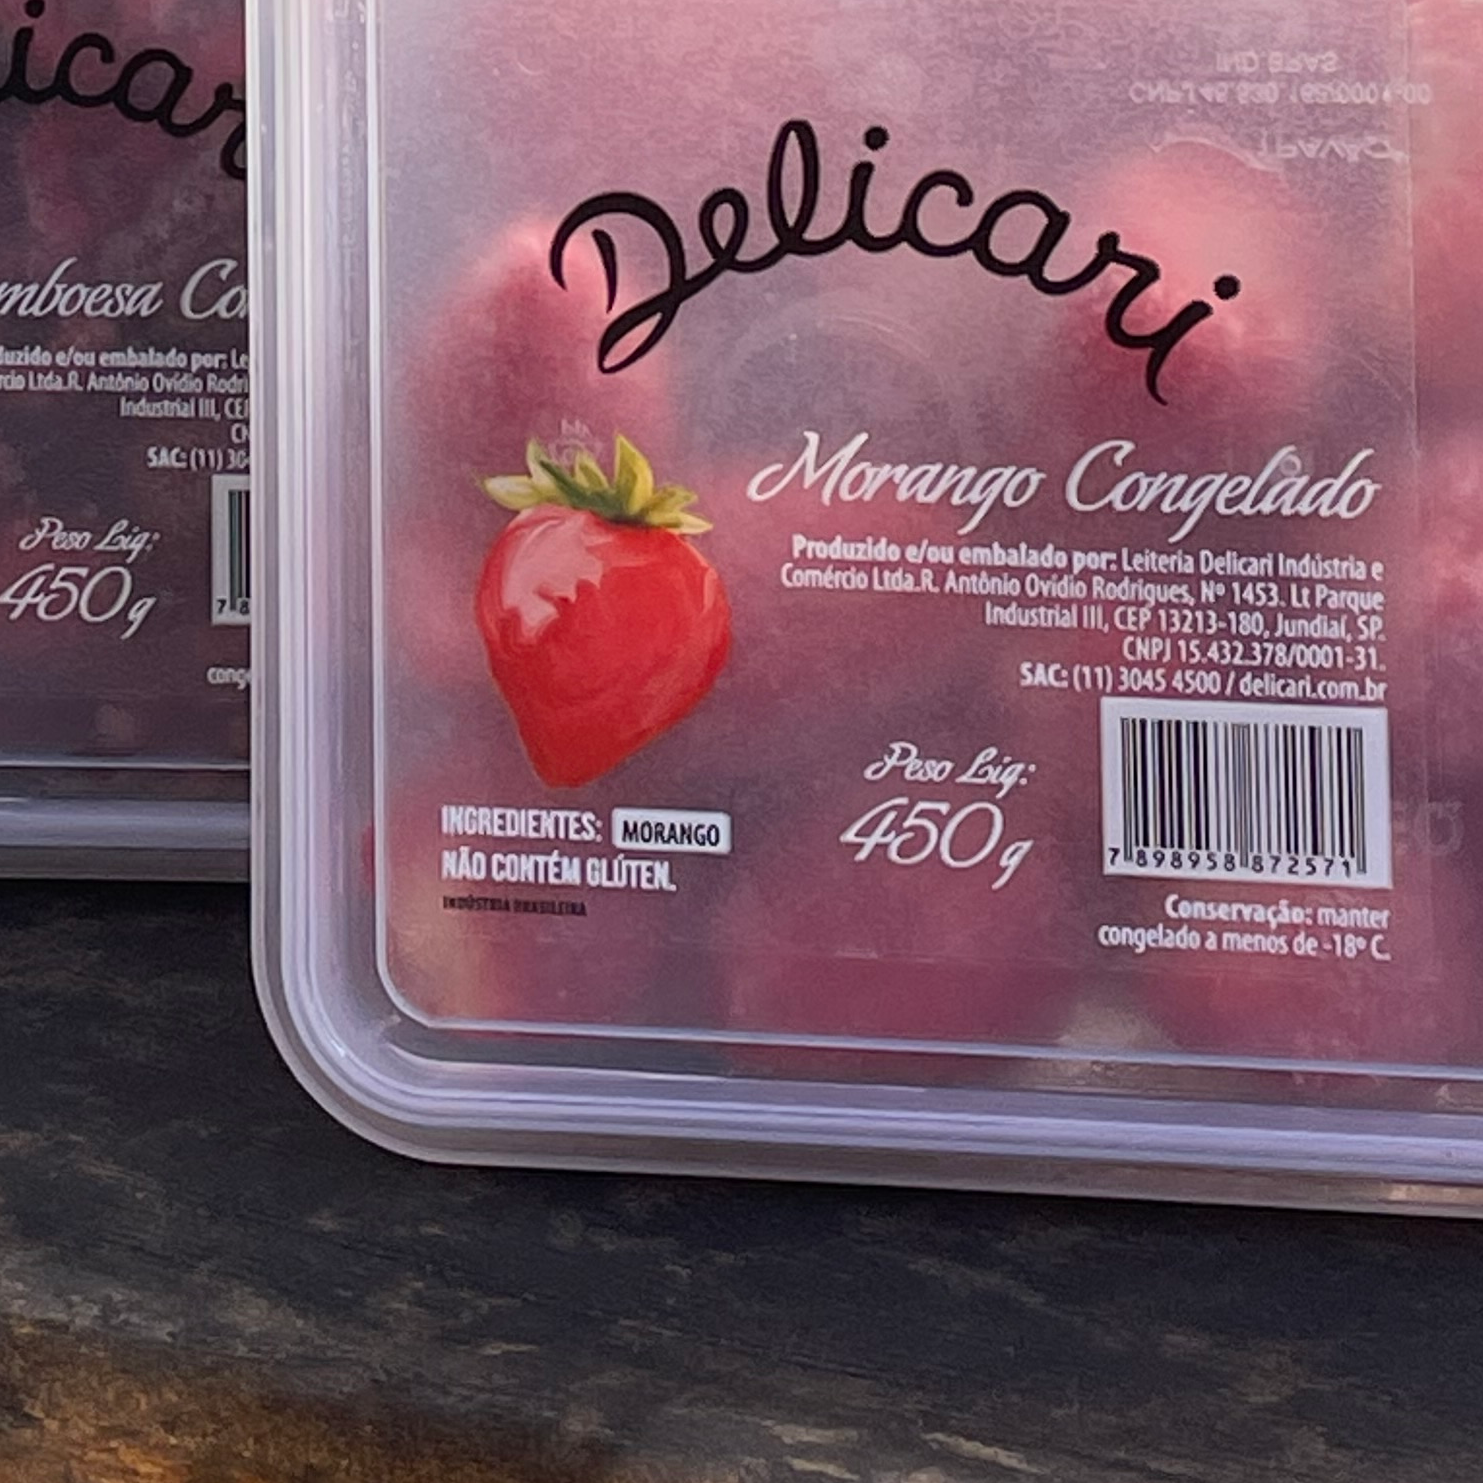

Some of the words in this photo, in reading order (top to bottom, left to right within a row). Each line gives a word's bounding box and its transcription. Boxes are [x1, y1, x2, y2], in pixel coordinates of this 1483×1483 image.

[548, 118, 1241, 407] Delicari
[55, 345, 95, 367] e/ou
[99, 346, 188, 368] embalado
[190, 351, 228, 374] por:
[119, 397, 195, 418] Industrial
[146, 446, 187, 469] SAC:
[190, 446, 224, 471] (11)
[746, 430, 1048, 537] Morango
[1065, 438, 1384, 545] Congelado
[18, 516, 93, 551] Peso
[791, 533, 901, 563] Produzido
[904, 539, 955, 564] e/ou
[958, 541, 1068, 569] embalado
[1072, 550, 1117, 576] por:
[1121, 547, 1195, 574] Leiteria
[1199, 549, 1274, 577] Delicari
[1278, 552, 1367, 581] Indústria
[1370, 560, 1384, 582] e
[780, 562, 869, 590] Comércio
[944, 569, 1021, 598] Antônio
[1092, 574, 1196, 608] Rodrigues,
[1231, 581, 1287, 608] 1453.
[1290, 583, 1311, 609] Lt
[1315, 583, 1385, 615] Parque
[985, 600, 1078, 629] Industrial
[1082, 603, 1110, 634] III,
[1114, 605, 1152, 633] CEP
[1157, 609, 1270, 640] 13213-180,
[1274, 612, 1353, 643] Jundiaí,
[1356, 615, 1387, 642] SP.
[1122, 635, 1172, 664] CNPJ
[1177, 638, 1387, 672] 15.432.378/0001-31.
[1019, 661, 1069, 689] SAC:
[1073, 664, 1114, 693] (11)
[1118, 667, 1167, 693] 3045
[1172, 668, 1222, 694] 4500
[1224, 669, 1236, 697] /
[1239, 671, 1388, 702] delicari.com.br
[863, 740, 955, 782] Peso
[441, 805, 604, 843] INGREDIENTES:
[621, 819, 720, 847] MORANGO
[839, 796, 1035, 891] 450g
[441, 845, 487, 881] NÃO
[491, 849, 581, 886] CONTÉM
[586, 853, 677, 892] GLÚTEN.
[1108, 847, 1120, 867] 7
[1135, 849, 1237, 873] 898958
[1251, 854, 1352, 879] 872571
[1165, 893, 1313, 930] Conservação:
[1317, 906, 1391, 930] manter
[1098, 922, 1202, 954] congelado
[1204, 930, 1218, 950] a
[1222, 930, 1290, 955] menos
[1292, 930, 1319, 956] de
